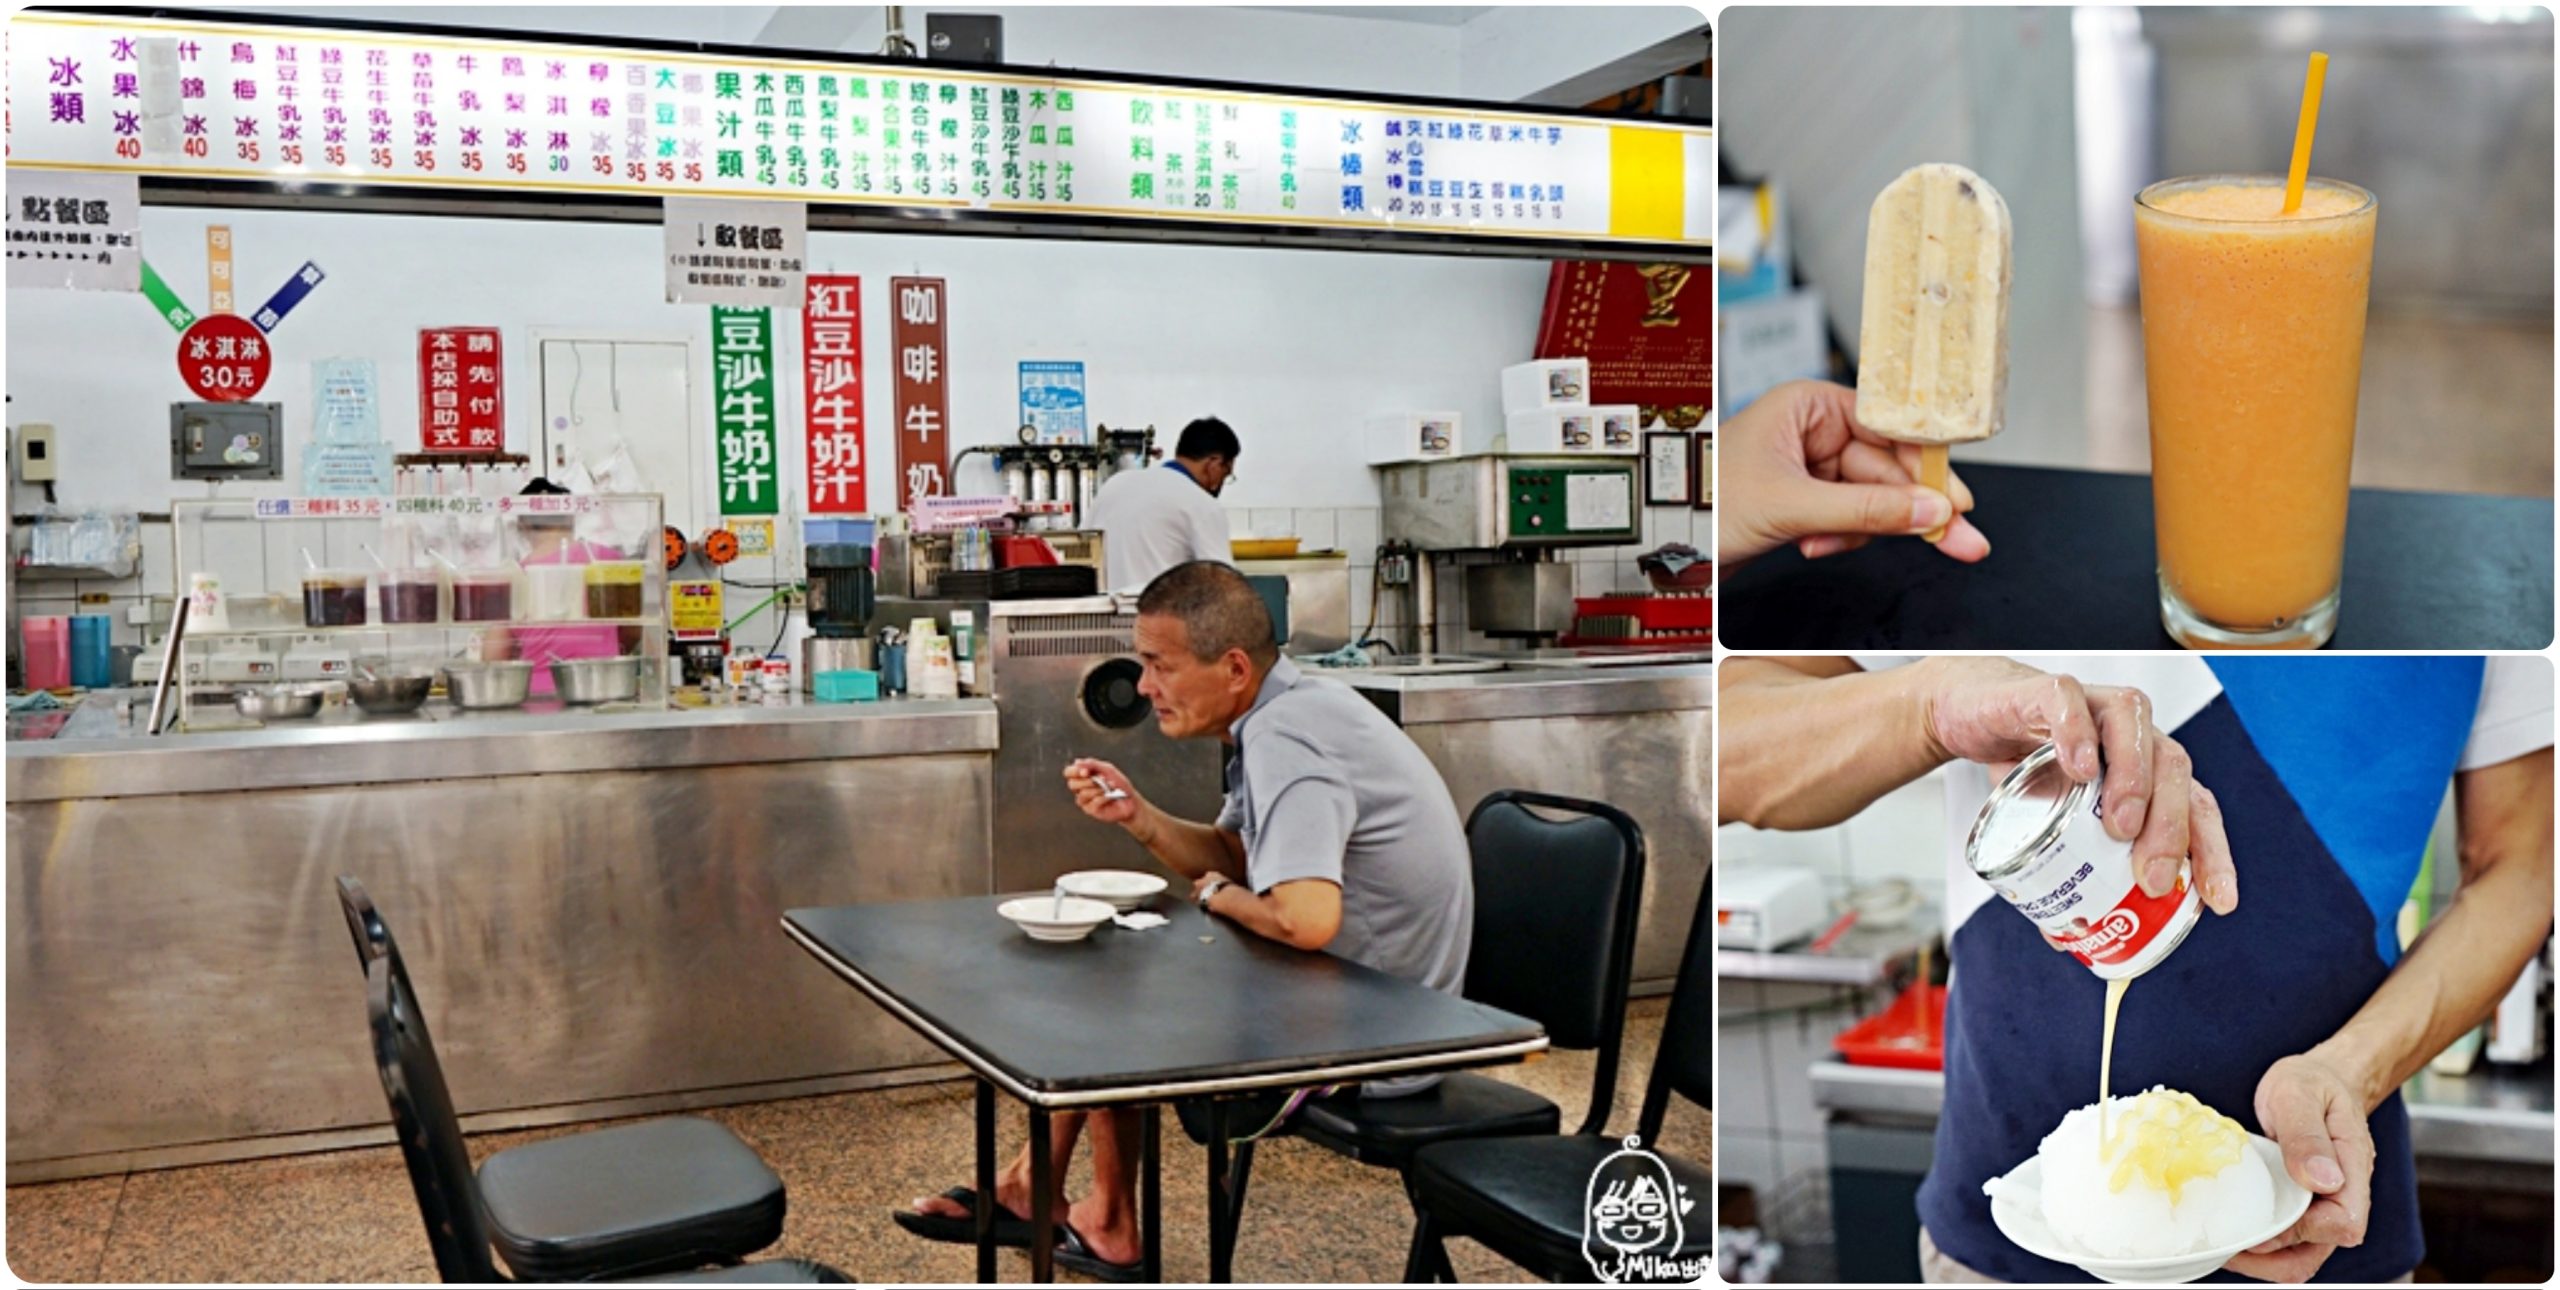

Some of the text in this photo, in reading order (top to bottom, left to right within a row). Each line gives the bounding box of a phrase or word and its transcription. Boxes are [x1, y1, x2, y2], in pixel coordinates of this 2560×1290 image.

[48, 56, 85, 124] 冰類
[111, 37, 141, 158] 水果冰 40
[179, 40, 208, 158] 什錦冰 40
[277, 46, 303, 165] 紅豆牛乳冰 35
[321, 48, 347, 166] 綠豆牛乳冰 35
[366, 50, 392, 168] 花生牛乳冰 35
[457, 55, 483, 171] 牛乳冰 35
[502, 57, 528, 173] 鳳梨冰 35
[545, 60, 570, 172] 冰淇淋 30
[655, 68, 677, 180] 大豆冰 35
[715, 71, 744, 178] 果汁類
[753, 73, 777, 186] 木瓜牛乳 45
[785, 75, 807, 187] 西瓜牛乳 45
[818, 76, 840, 189] 鳳梨牛乳 45
[971, 87, 990, 198] 紅豆沙牛乳 45
[1028, 89, 1048, 181] 木瓜汁
[1056, 90, 1074, 181] 西瓜汁
[238, 141, 260, 162] 35
[414, 150, 436, 170] 35
[592, 154, 614, 175] 35
[627, 163, 647, 182] 35
[683, 163, 702, 182] 35
[912, 176, 930, 194] 45
[1002, 180, 1020, 199] 45
[1130, 99, 1154, 199] 飲料類
[1195, 193, 1211, 207] 20
[190, 336, 262, 359] 冰淇淋
[200, 367, 254, 387] 30元
[432, 333, 460, 445] 本店採自助式
[468, 333, 497, 445] 請先付款
[718, 304, 771, 502] 豆沙牛奶汁
[808, 284, 860, 503] 紅豆沙牛奶汁
[901, 287, 945, 499] 咖啡牛奶
[2039, 862, 2094, 907] BEVERAGE
